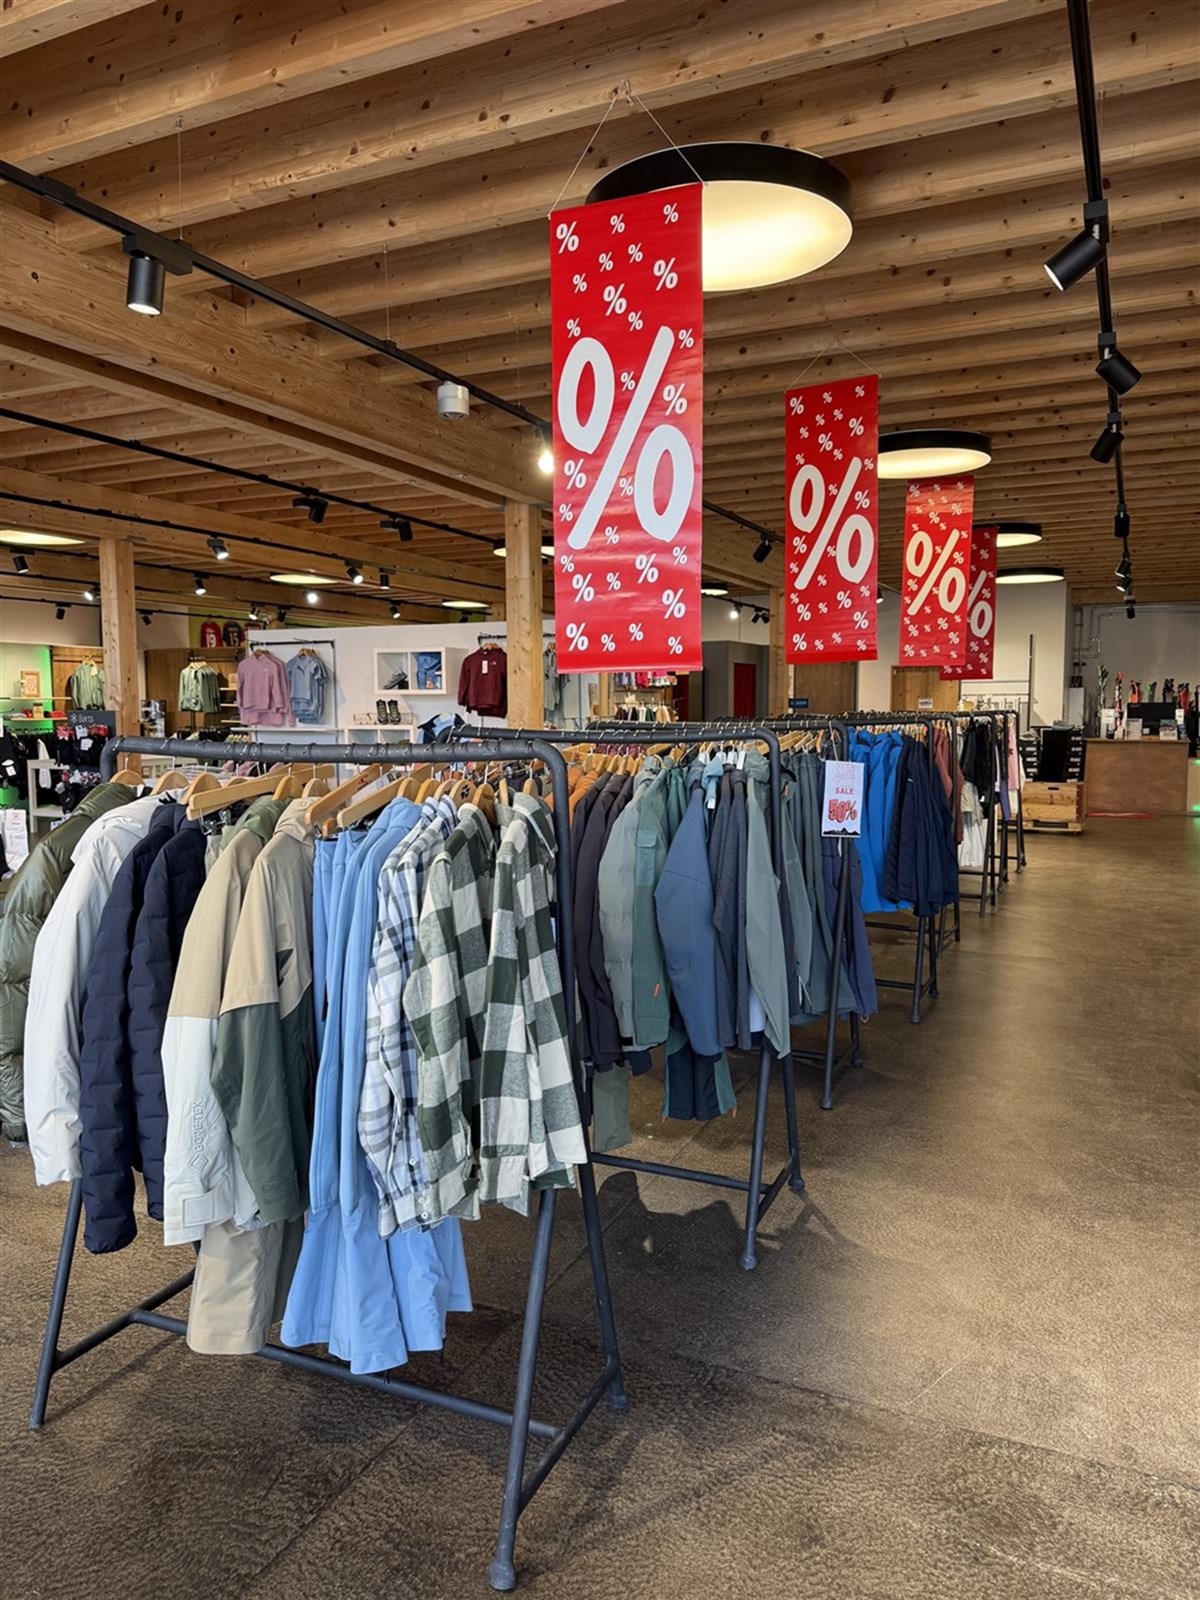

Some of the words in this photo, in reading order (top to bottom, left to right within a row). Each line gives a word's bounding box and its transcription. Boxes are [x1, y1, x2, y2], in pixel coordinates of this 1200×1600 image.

[558, 326, 694, 550] %
[789, 457, 874, 590] %
[906, 528, 965, 615] %
[205, 633, 217, 648] 19
[229, 632, 239, 646] 15
[78, 713, 94, 723] Barts
[835, 787, 854, 795] SALE
[828, 798, 858, 823] 50%
